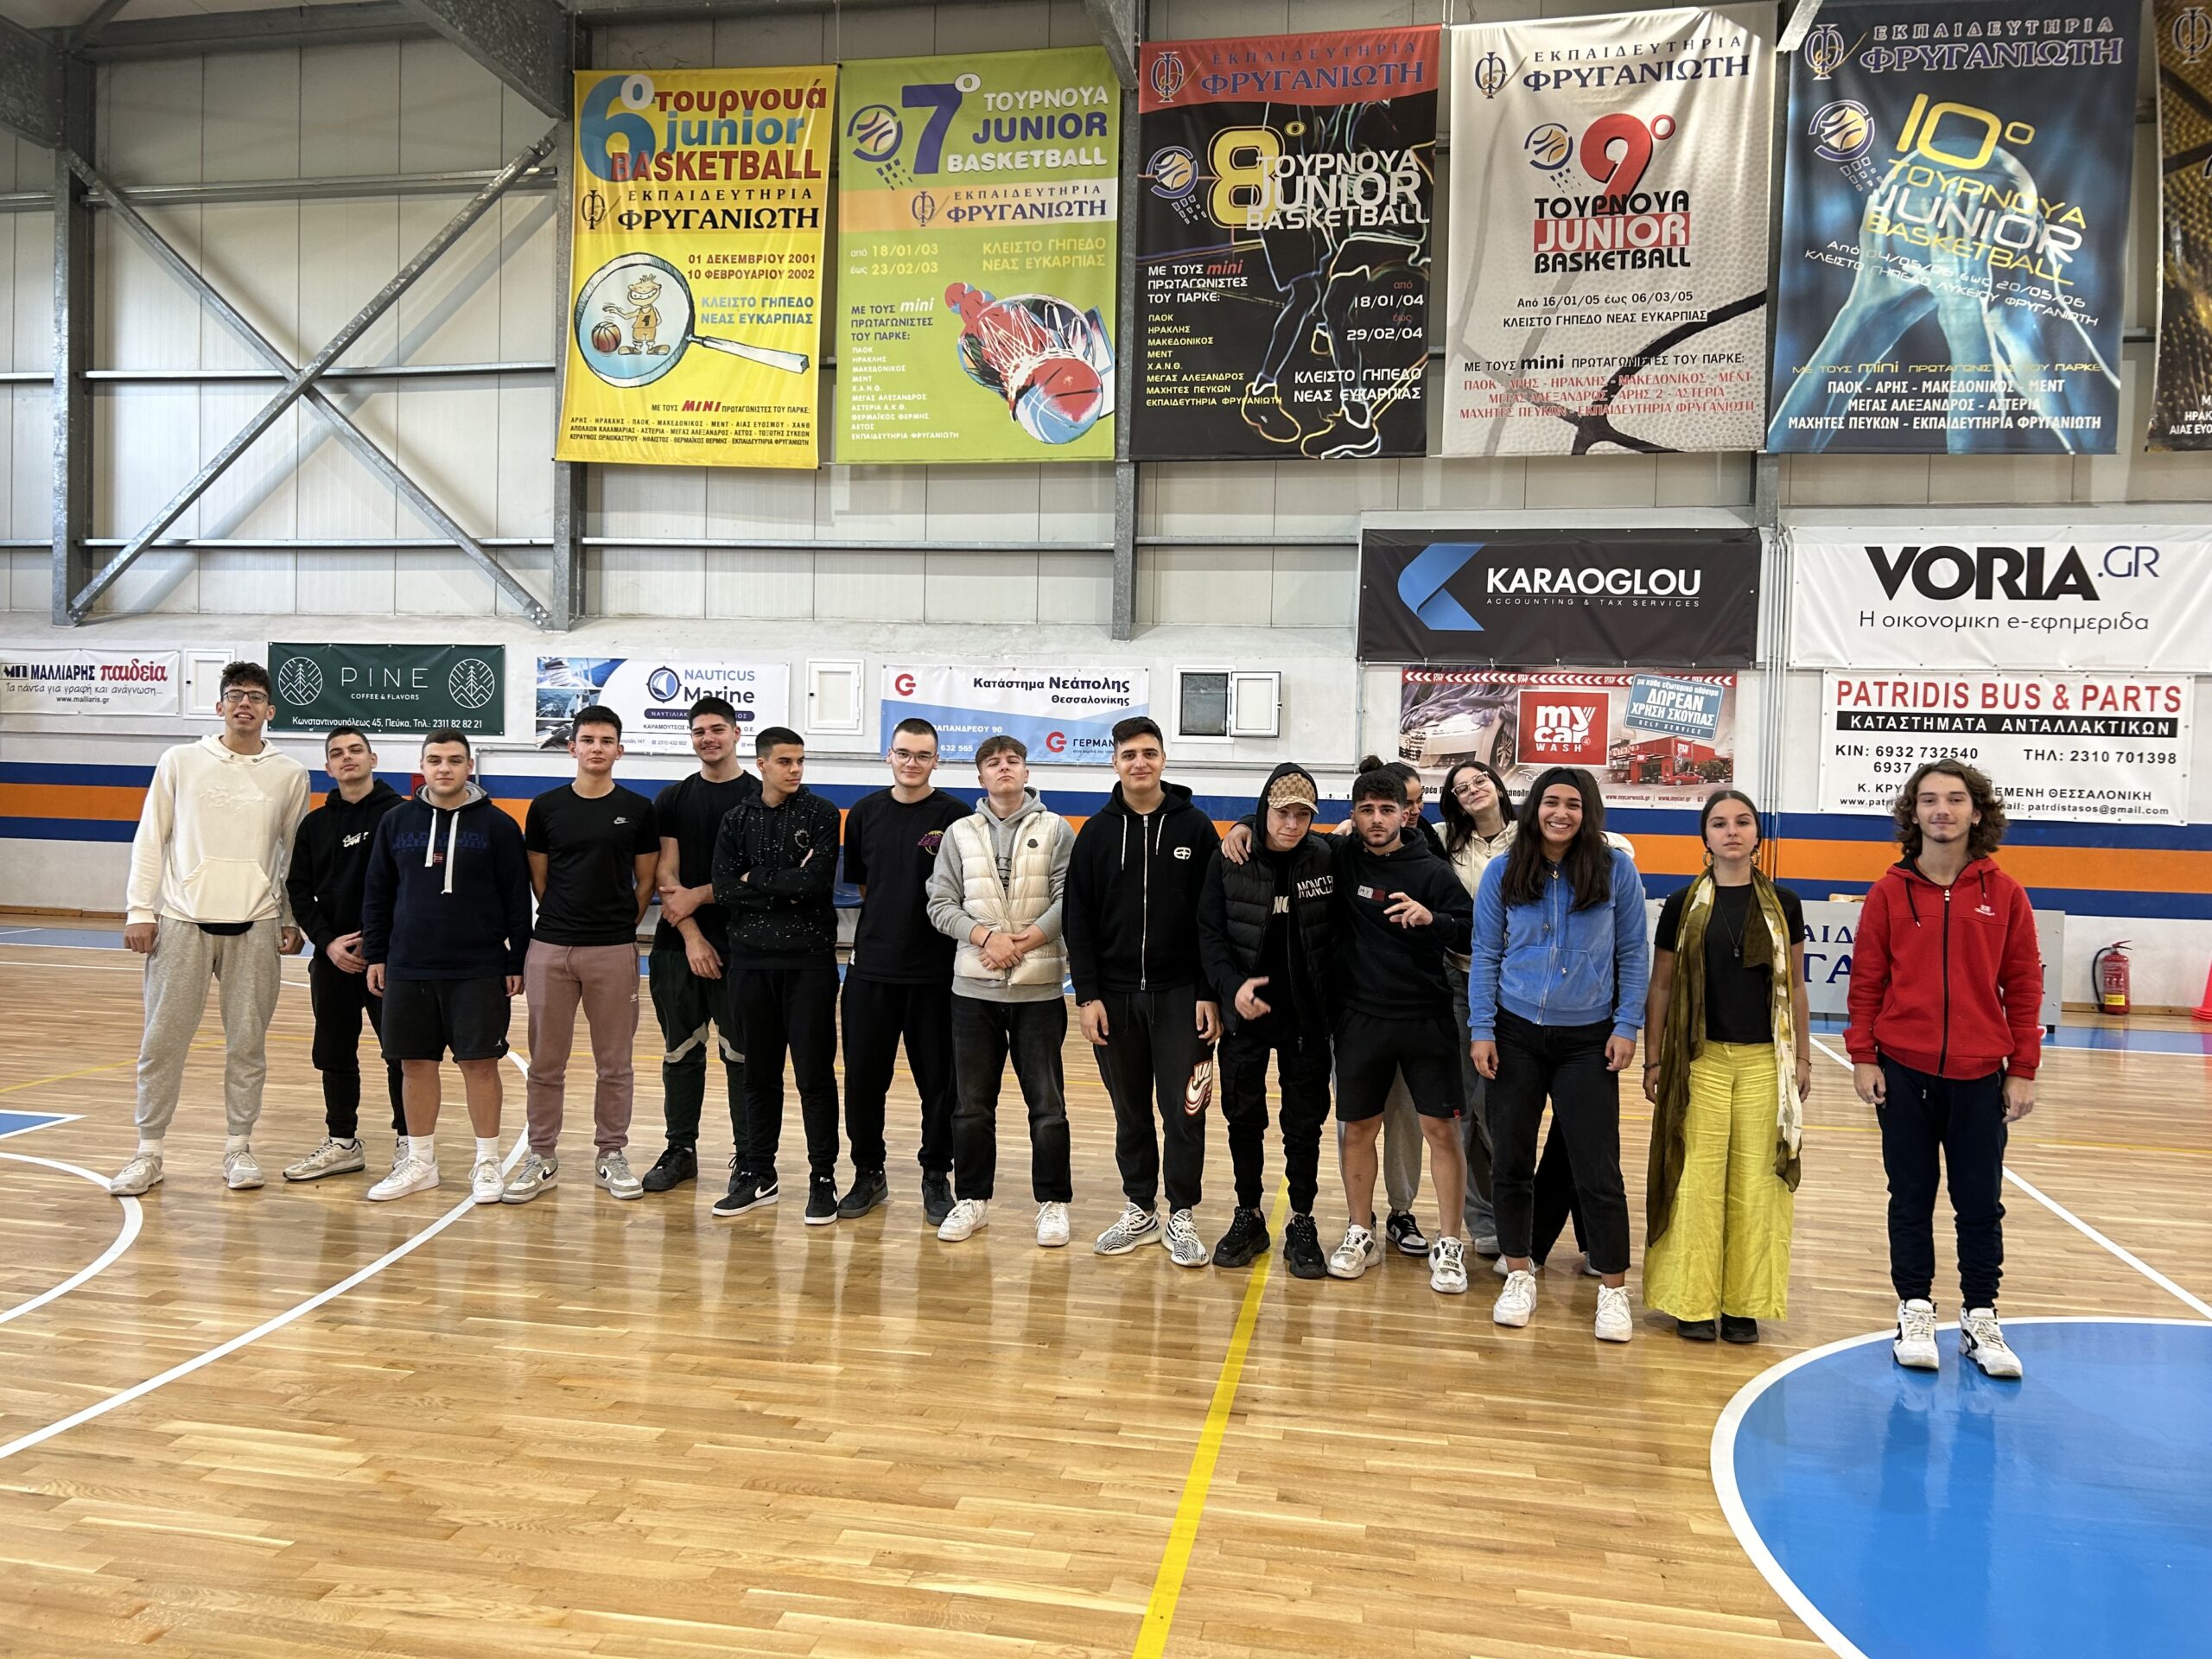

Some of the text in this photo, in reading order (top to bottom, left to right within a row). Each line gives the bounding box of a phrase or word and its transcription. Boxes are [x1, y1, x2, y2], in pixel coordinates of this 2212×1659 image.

[1873, 16, 2114, 41] ΕΚΠΑΙΔΕΥΤΗΡΙΑ
[1213, 41, 1415, 65] ΕΚΠΑΙΔΕΥΤΗΡΙΑ
[1535, 35, 1740, 62] ΕΚΠΑΙΔΕΥΤΗΡΙΑ
[1859, 37, 2124, 73] ΦΡΥΓΑΝΙΩΤΗ
[1201, 61, 1424, 95] ΦΡΥΓΑΝΙΩΤΗ
[1523, 54, 1750, 92] ΦΡΥΓΑΝΙΩΤΗ
[983, 86, 1109, 112] ΤΟΥΡΝΟΥΑ
[664, 110, 804, 153] junior
[972, 111, 1107, 144] JUNIOR
[611, 149, 821, 181] BASKETBALL
[947, 146, 1107, 173] BASKETBALL
[1255, 149, 1420, 179] ΤΟΥΡΝΟΥΑ
[628, 188, 812, 201] ΕΚΠΑΙΔΕΥΤΗΡΙΑ
[955, 185, 1100, 200] ΕΚΠΑΙΔΕΥΤΗΡΙΑ
[1252, 171, 1421, 212] JUNIOR
[1888, 158, 2087, 230] ΤΟΥΡΝΟΥΑ
[947, 200, 1107, 223] ΦΡΥΓΑΝΙΩΤΗ
[1534, 190, 1689, 219] ΤΟΥΡΝΟΥΑ
[618, 207, 819, 230] ΦΡΥΓΑΝΙΩΤΗ
[1246, 203, 1430, 231] BASKETBALL
[1537, 214, 1687, 251] JUNIOR
[873, 244, 938, 257] 18/01/03
[983, 238, 1106, 254] ΚΛΕΙΣΤΟ ΓΗΠΕΔΟ
[707, 254, 816, 264] ΔΕΚΕΜΒΡΙΟΥ 2001
[982, 254, 1106, 270] ΝΕΑΣ ΕΥΚΑΡΠΙΑΣ
[1534, 248, 1691, 273] BASKETBALL
[705, 270, 815, 279] ΦΕΒΡΟΥΑΡΙΟΥ 2002
[872, 263, 938, 276] 23/02/03
[1148, 259, 1243, 276] ΜΕ ΤΟΥΣ mini
[1148, 277, 1248, 289] ΠΡΩΤΑΓΩΝΙΣΤΕΣ
[1147, 292, 1220, 303] ΤΟΥ ΠΑΡΚΕ:
[1543, 291, 1693, 308] 16/01/05 06/03/05
[1936, 282, 1999, 302] ΛΥΚΕΙΟΥ
[1996, 279, 2086, 308] 20/05/06
[702, 297, 814, 308] ΚΛΕΙΣΤΟ ΓΗΠΕΔΟ
[870, 297, 934, 314] ΤΟΥΣ mini
[1354, 295, 1424, 308] 18/01/04
[701, 314, 813, 324] ΝΕΑΣ ΕΥΚΑΡΠΙΑΣ
[851, 317, 933, 327] ΠΡΩΤΑΓΩΝΙΣΤΕΣ
[1503, 310, 1707, 327] ΚΛΕΙΣΤΟ ΓΗΠΕΔΟ ΝΕΑΣ ΕΥΚΑΡΠΙΑΣ
[851, 333, 870, 341] ΤΟΥ
[1148, 337, 1213, 346] ΜΑΚΕΔΟΝΙΚΟΣ
[1346, 327, 1423, 342] 29/02/04
[1147, 350, 1173, 359] ΜΕΝΤ
[1486, 353, 1745, 371] ΤΟΥΣ mini ΤΟΥ ΠΑΡΚΕ:
[1859, 361, 1899, 372] mini
[1294, 368, 1421, 384] ΚΛΕΙΣΤΟ ΓΗΠΕΔΟ
[1551, 373, 1707, 387] ΗΡΑΚΛΗΣ ΜΑΚΕΔΟΝΙΚΟΣ
[1827, 379, 2065, 393] ΠΑΟΚ ΑΡΗΣ ΜΑΚΕΔΟΝΙΚΟΣ ΜΕΝΤ
[1146, 397, 1217, 406] ΕΚΠΑΙΔΕΥΤΗΡΙΑ
[1294, 387, 1421, 403] ΝΕΑΣ ΕΥΚΑΡΠΙΑΣ
[681, 400, 721, 412] MINI
[1848, 398, 2041, 411] ΜΕΓΑΣ ΑΛΕΞΑΝΔΡΟΣ ΑΣΤΕΡΙΑ
[1788, 416, 2101, 429] ΜΑΧΗΤΕΣ ΠΕΥΚΩΝ ΕΚΠΑΙΔΕΥΤΗΡΙΑ ΦΡΥΓΑΝΙΩΤΗ
[1486, 567, 1700, 596] KARAOGLOU
[1632, 599, 1700, 607] SERVICES
[1859, 612, 2149, 634] Η οικονομικη e-εφημεριδα
[31, 658, 168, 682] ΜΑΛΛΙΑΡΗΣ παιδεία
[341, 667, 429, 688] PINE
[683, 670, 755, 682] NAUTICUS
[48, 685, 60, 695] για
[64, 683, 92, 695] γραφή
[974, 677, 1130, 692] Κατάστημα Νεάπολης
[56, 696, 110, 704] www.malliaris.gr
[1051, 695, 1129, 706] Θεσσαλονίκης
[1646, 688, 1705, 712] ΔΩΡΕΑΝ
[1837, 680, 2182, 713] PATRIDIS BUS & PARTS
[292, 716, 449, 728] Κωνσταντινουπόλεως 2311
[1536, 705, 1597, 732] my
[1630, 702, 1715, 727] ΧΡΗΣΗ ΣΚΟΥΠΑΣ
[1638, 720, 1702, 734] SELF SERVICE
[1851, 715, 2170, 735] ΚΑΤΑΣΤΗΜΑΤΑ ΑΝΤΑΛΛΑΚΤΙΚΩΝ
[1534, 727, 1589, 743] car
[1875, 746, 1914, 758] 6932
[1920, 747, 1978, 759] 732540
[2024, 748, 2177, 765] ΤΗΛ: 2310 701398
[1873, 761, 1911, 773] 6937
[2049, 788, 2152, 801] ΘΕΣΣΑΛΟΝΙΚΗ
[2028, 803, 2169, 815] patrdistasos@gmail.com
[1297, 875, 1333, 899] MONCLE
